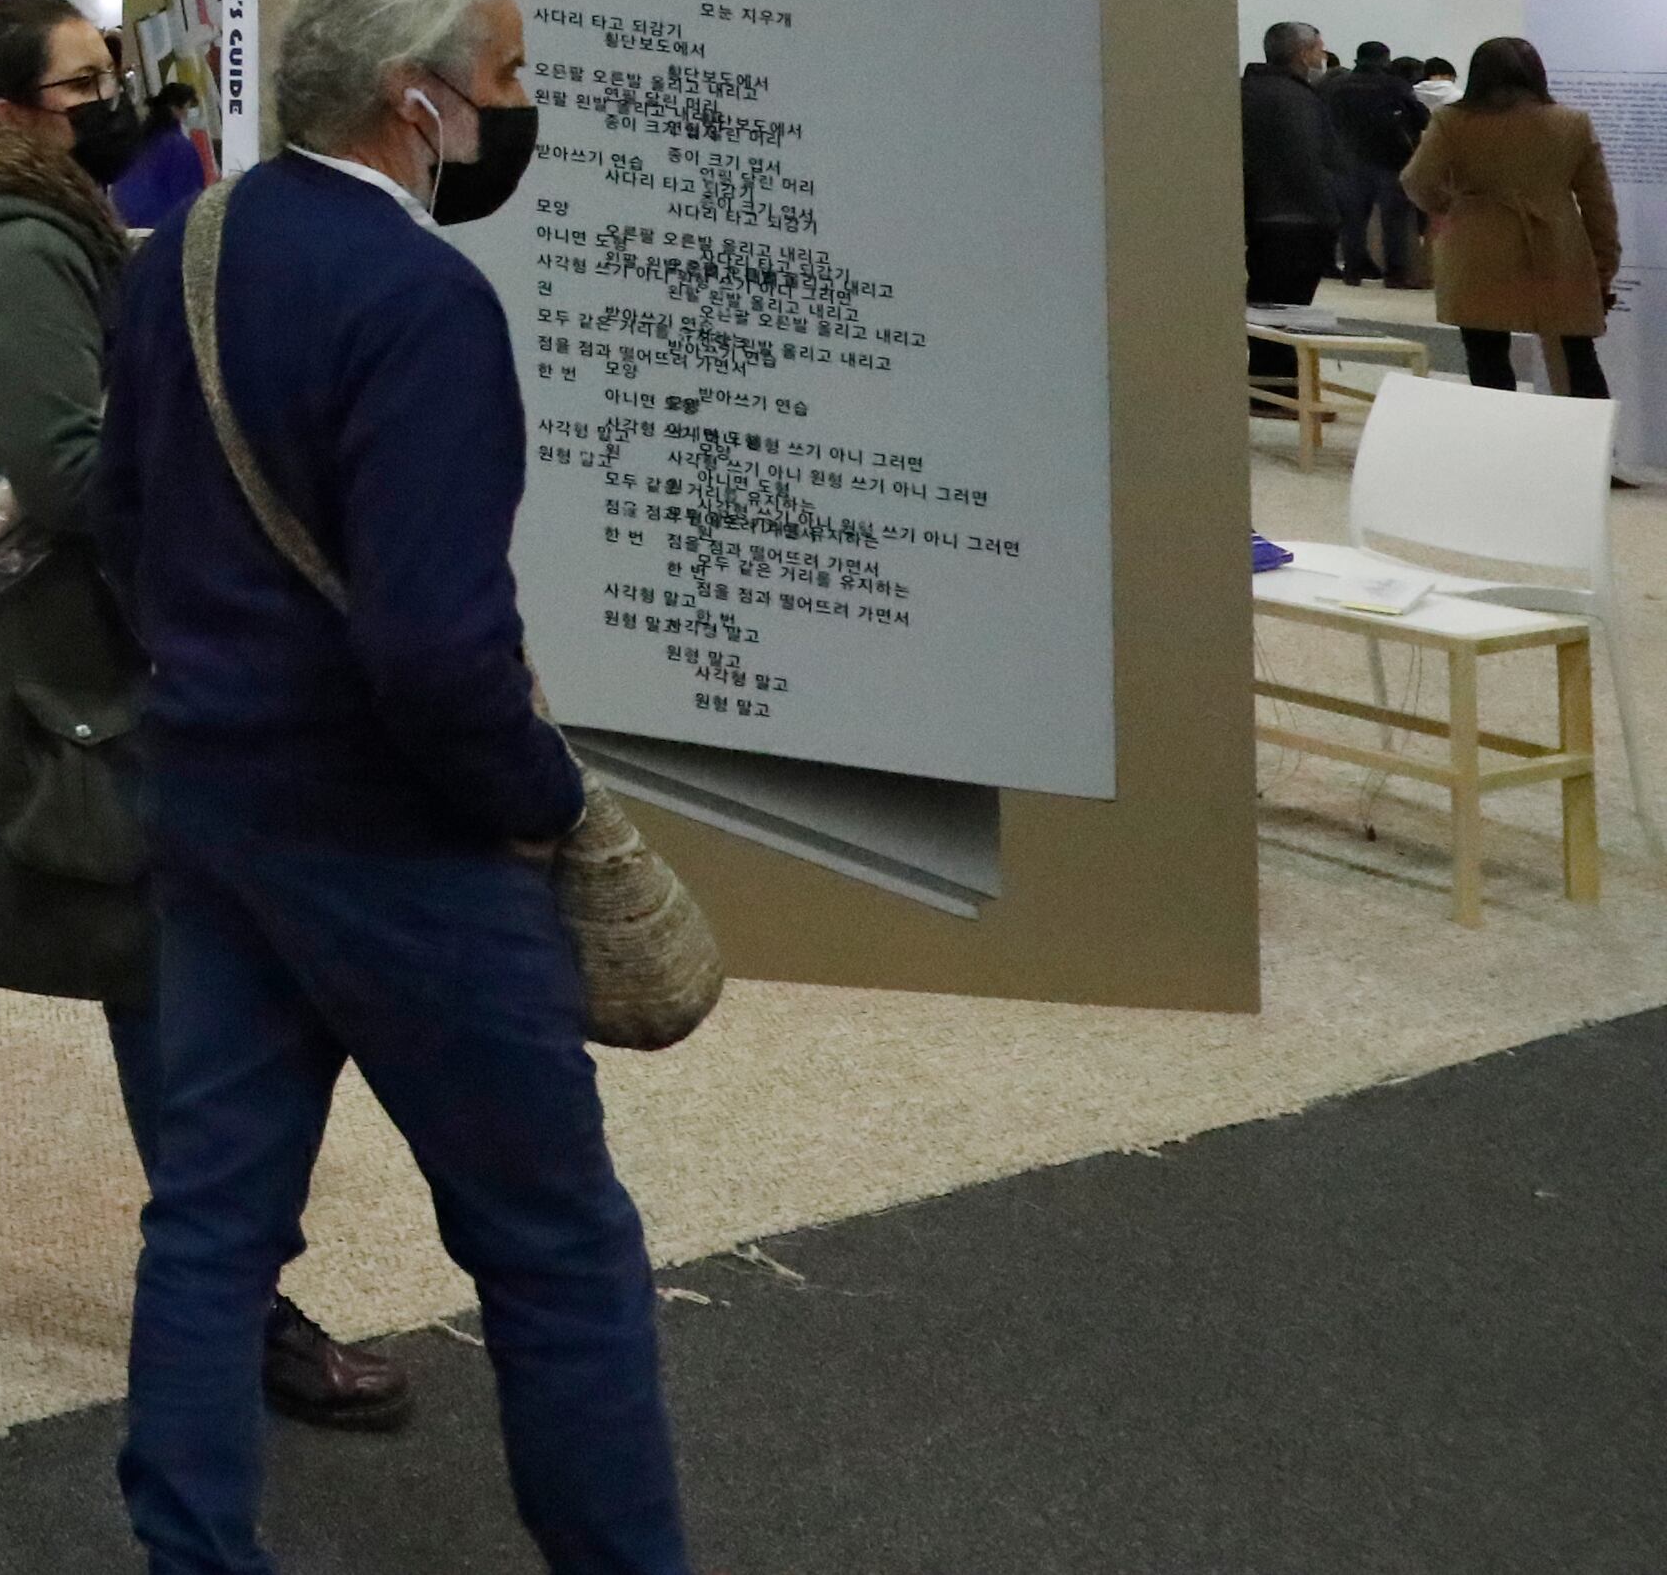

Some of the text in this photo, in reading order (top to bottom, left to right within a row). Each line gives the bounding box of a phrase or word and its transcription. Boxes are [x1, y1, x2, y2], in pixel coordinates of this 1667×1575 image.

[533, 8, 584, 27] 사다리
[591, 14, 624, 31] 타고
[741, 7, 793, 29] 지우개
[229, 28, 243, 115] GUIDE
[782, 178, 815, 196] 머리
[536, 226, 587, 247] 아니면
[876, 328, 927, 348] 내리고
[840, 351, 892, 371] 내리고
[537, 363, 577, 383] 한 번
[829, 446, 863, 465] 아니
[872, 451, 924, 473] 그러면
[768, 463, 802, 482] 아니
[851, 475, 885, 495] 쓰기
[892, 481, 927, 500] 아니
[935, 486, 988, 508] 그러면
[628, 528, 644, 546] 번
[882, 525, 1020, 558] 쓰기 아니 그러면
[828, 556, 879, 578] 가면서
[840, 574, 910, 599] 유지하는
[858, 605, 910, 628] 가면서
[755, 673, 789, 693] 말고
[736, 698, 771, 718] 말고
